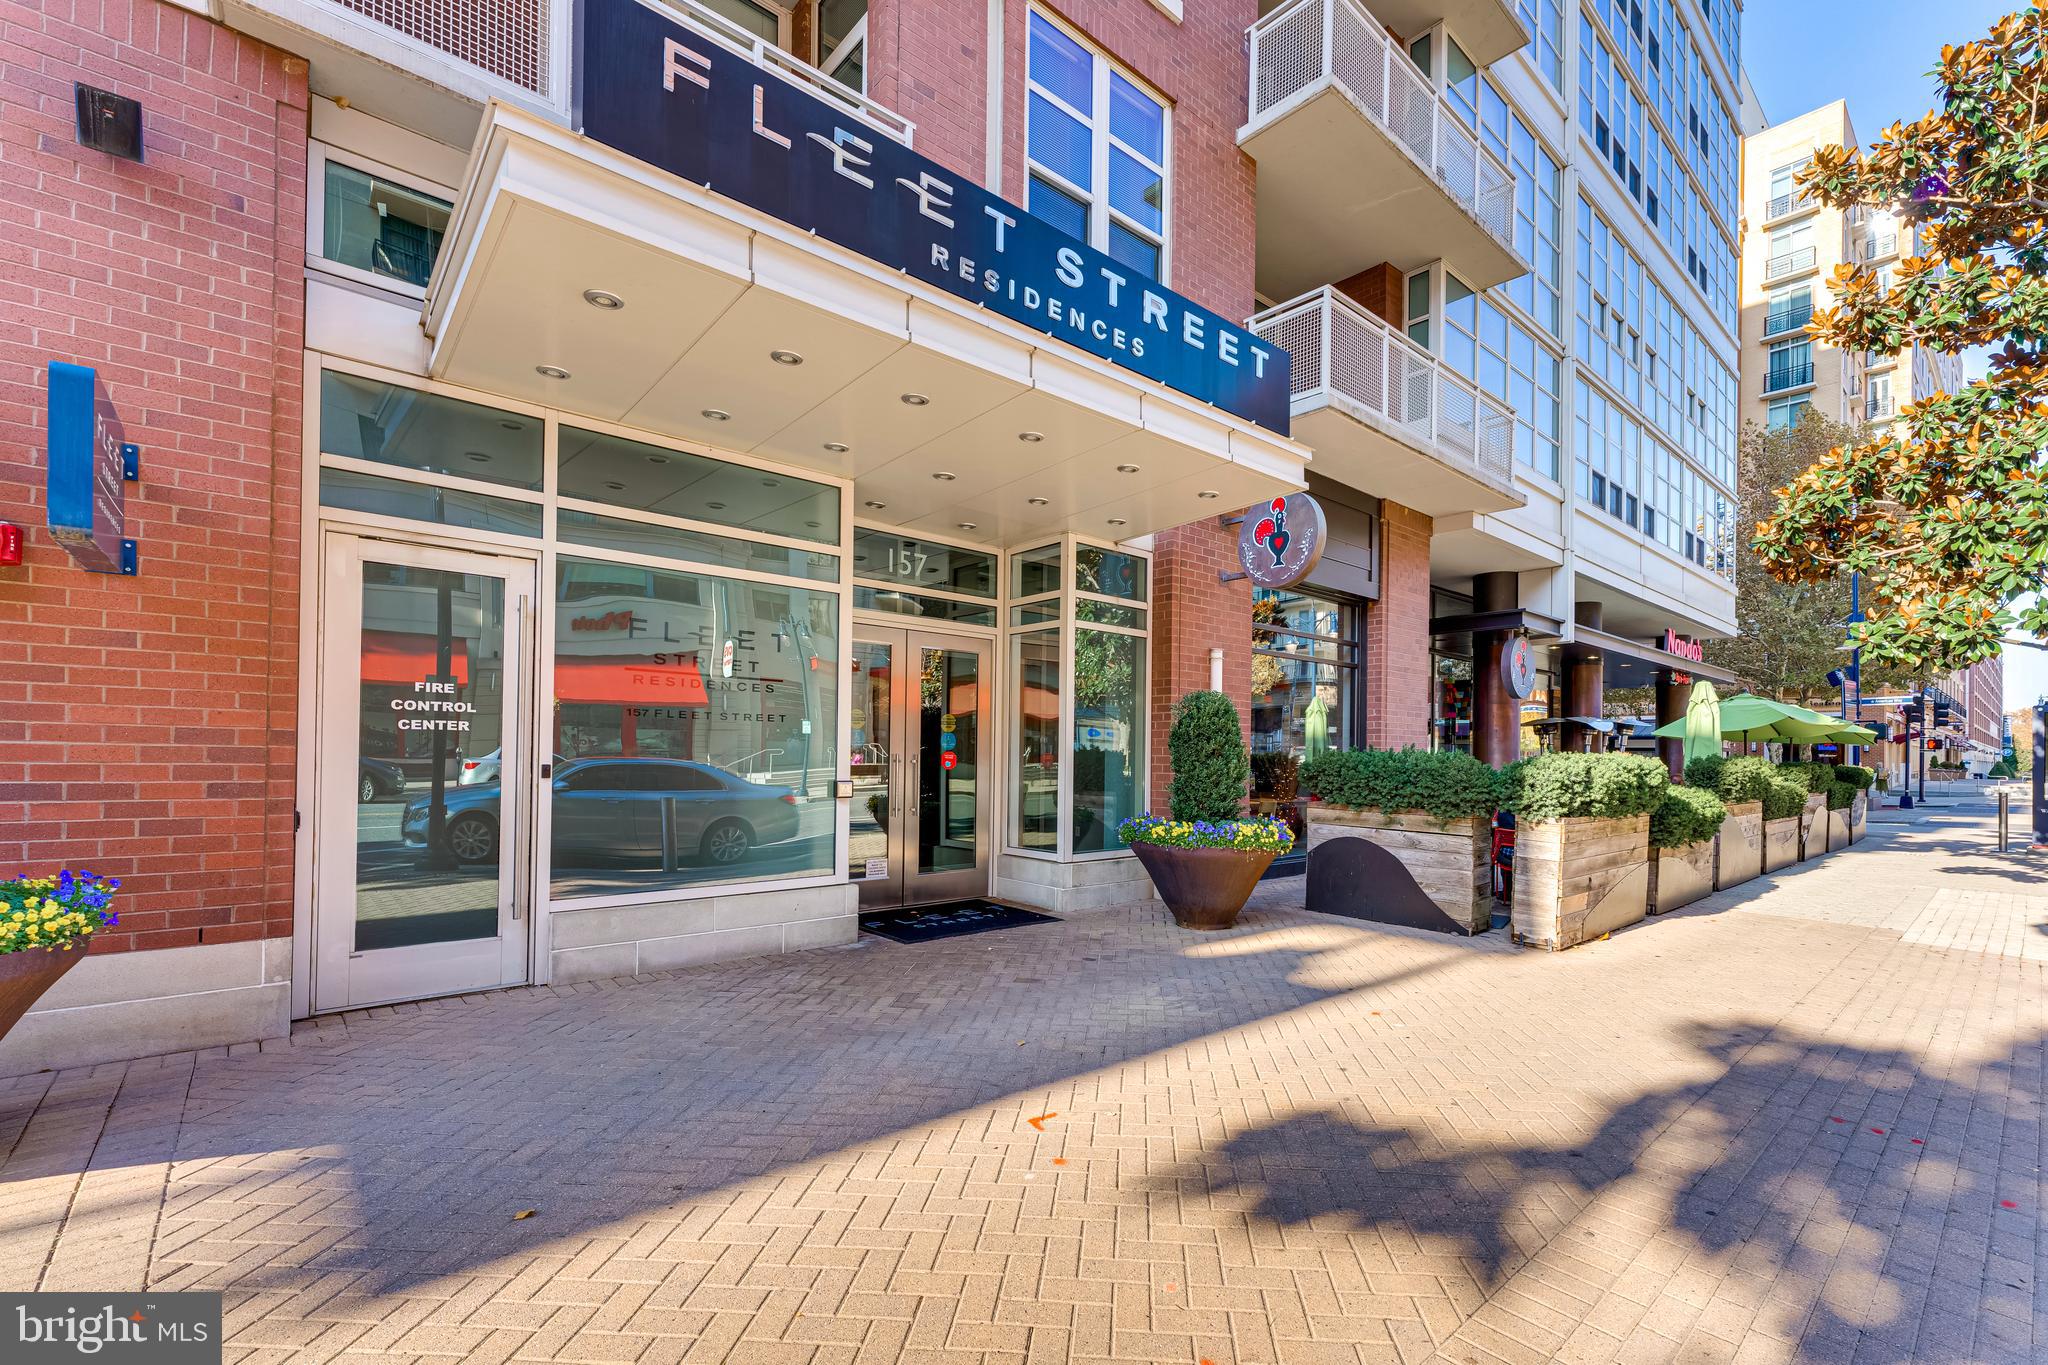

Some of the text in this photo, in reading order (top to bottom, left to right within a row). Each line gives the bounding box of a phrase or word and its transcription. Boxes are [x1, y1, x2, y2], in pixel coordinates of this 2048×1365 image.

[663, 36, 1270, 379] FLEET STREET
[931, 242, 1145, 358] RESIDENCES
[97, 412, 125, 480] FLEET
[888, 548, 928, 577] 157
[628, 616, 787, 654] FLEET
[1667, 627, 1702, 662] Nando's
[653, 653, 760, 674] STREET
[414, 681, 455, 694] FIRE
[632, 674, 776, 694] RESIDENCES
[390, 699, 477, 713] CONTROL
[626, 707, 788, 723] 157 FLEET STREET
[397, 718, 470, 732] CENTER
